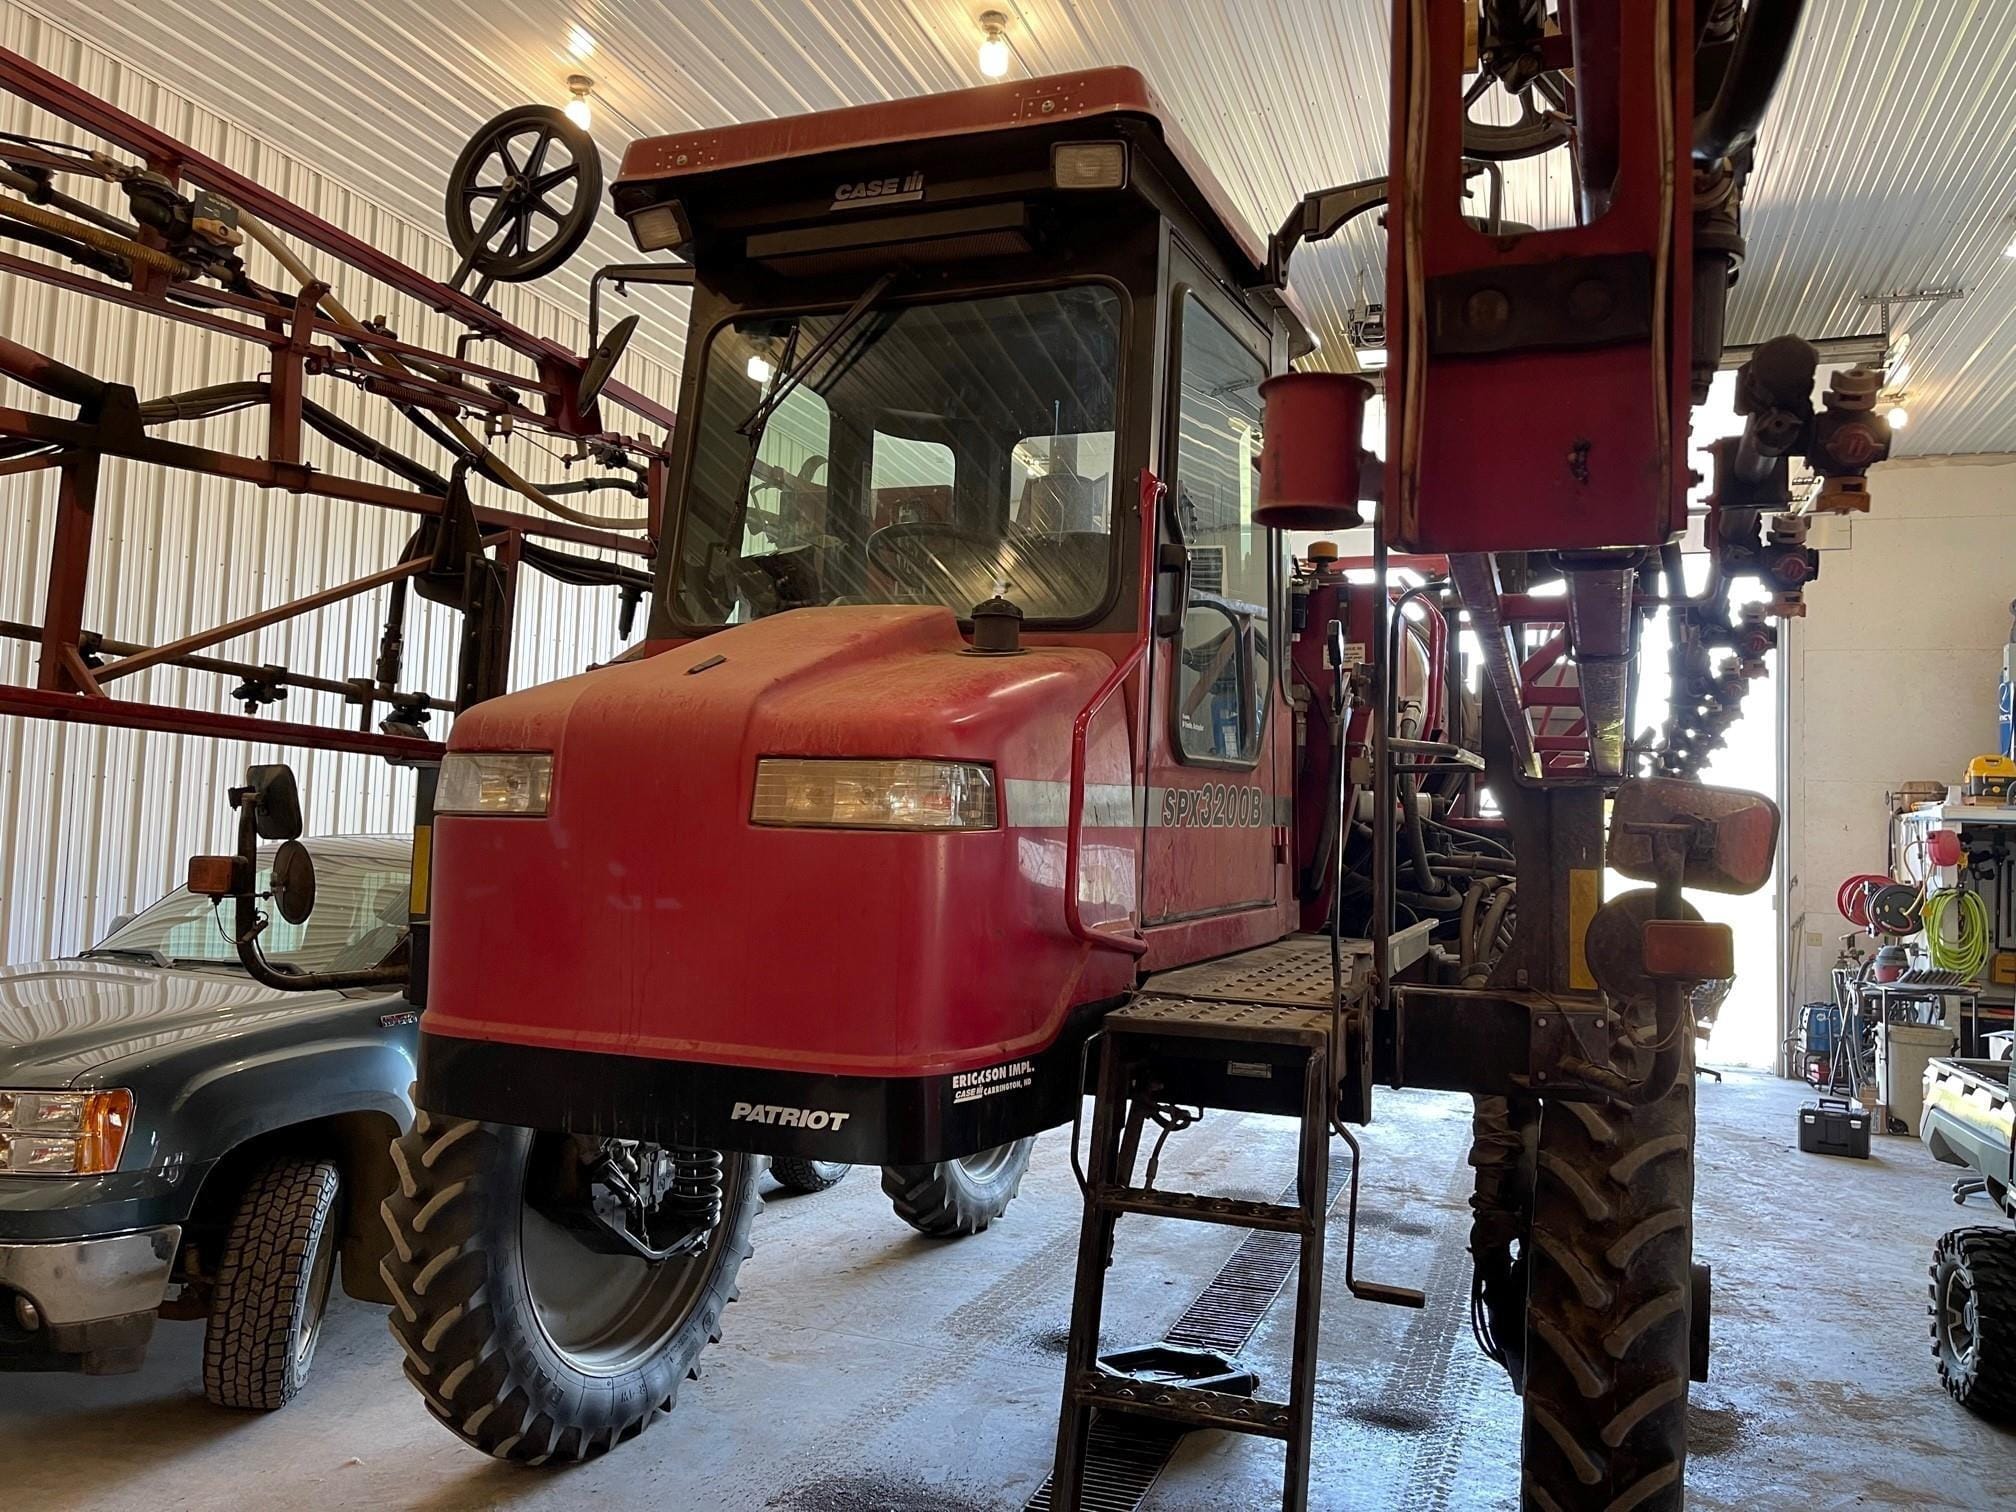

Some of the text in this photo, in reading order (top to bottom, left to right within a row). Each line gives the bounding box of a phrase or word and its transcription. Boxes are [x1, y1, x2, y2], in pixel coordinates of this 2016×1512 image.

[834, 178, 900, 201] CASE
[1162, 782, 1263, 828] SPX3200B
[952, 1060, 1035, 1089] ERICKSON IMPL.
[983, 1078, 1032, 1096] CARRINGTON, ND
[955, 1088, 976, 1099] CASE
[731, 1102, 850, 1132] PATRIOT
